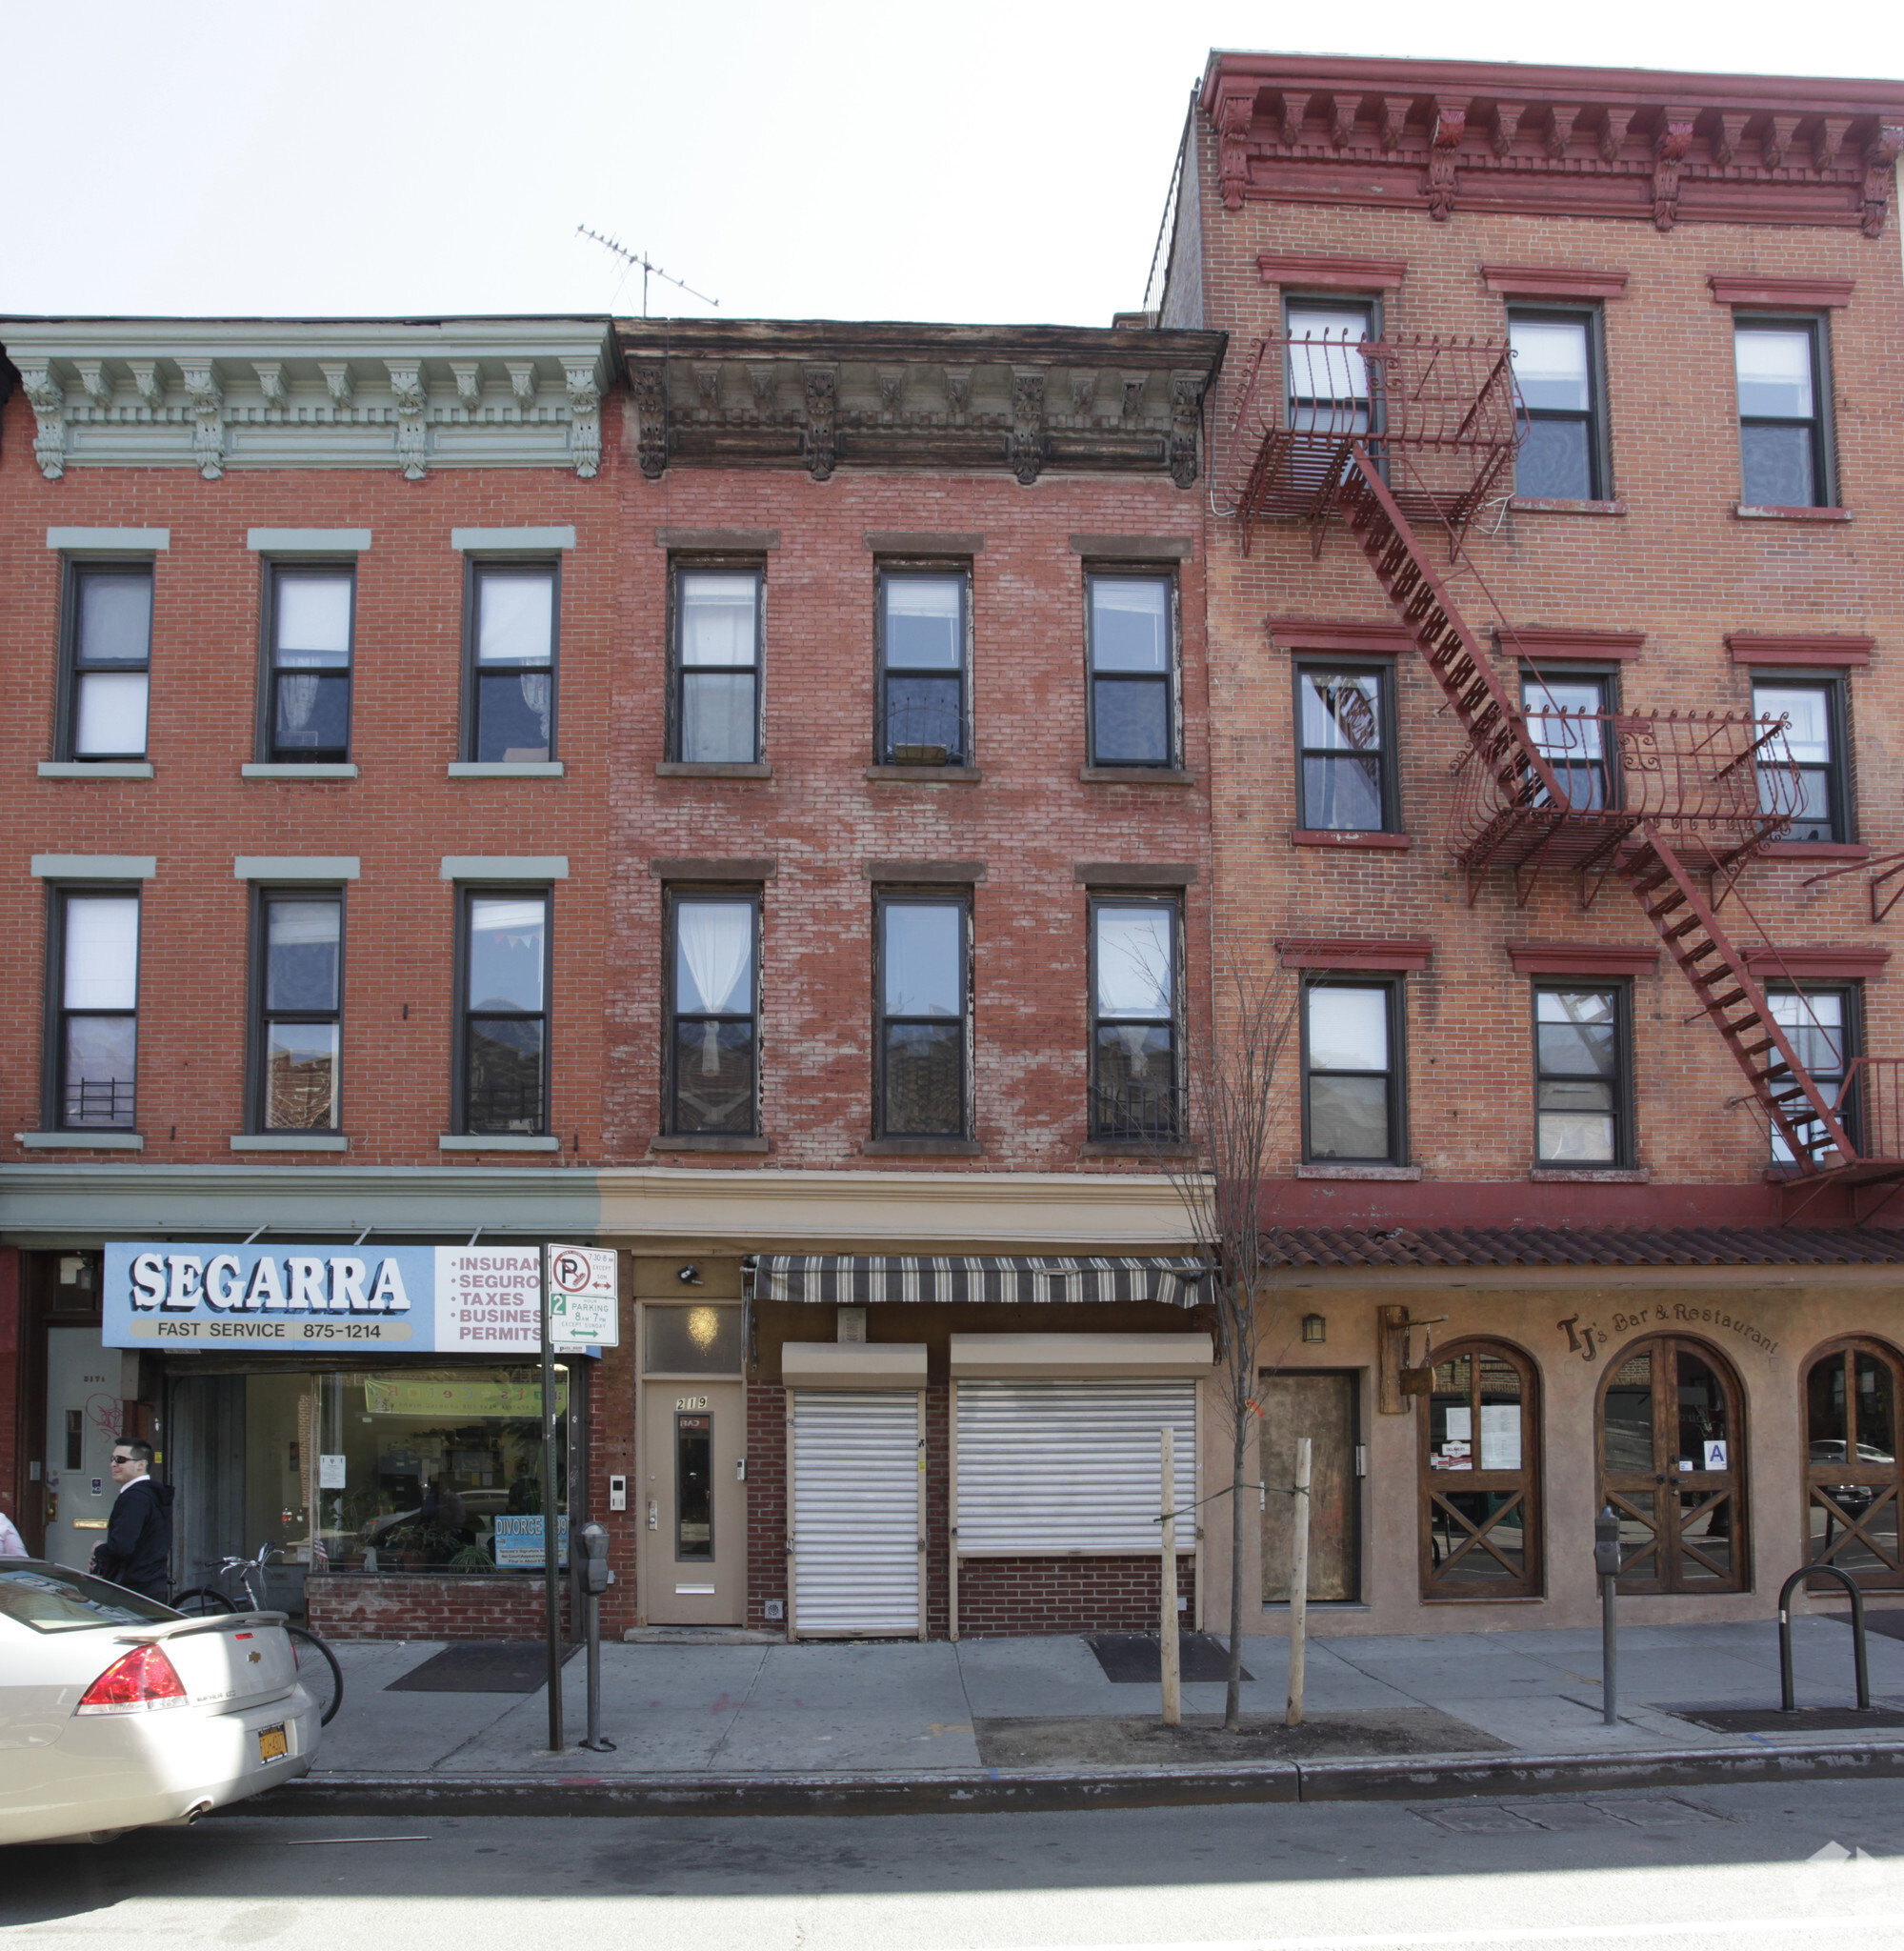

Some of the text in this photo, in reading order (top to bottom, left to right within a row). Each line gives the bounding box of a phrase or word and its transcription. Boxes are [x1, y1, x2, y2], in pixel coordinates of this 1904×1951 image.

[130, 1252, 411, 1314] SEGARRA
[460, 1293, 525, 1306] TAXES
[552, 1295, 564, 1315] 2
[571, 1302, 610, 1313] PARKING
[157, 1322, 382, 1338] FAST SERVICE 875-1214
[584, 1321, 606, 1330] SUNDAY
[1613, 1308, 1649, 1332] Bar
[1655, 1304, 1670, 1320] &
[1673, 1303, 1780, 1355] Restaurant
[677, 1397, 707, 1410] 219
[1710, 1444, 1724, 1462] A
[496, 1519, 542, 1536] DIVORCE
